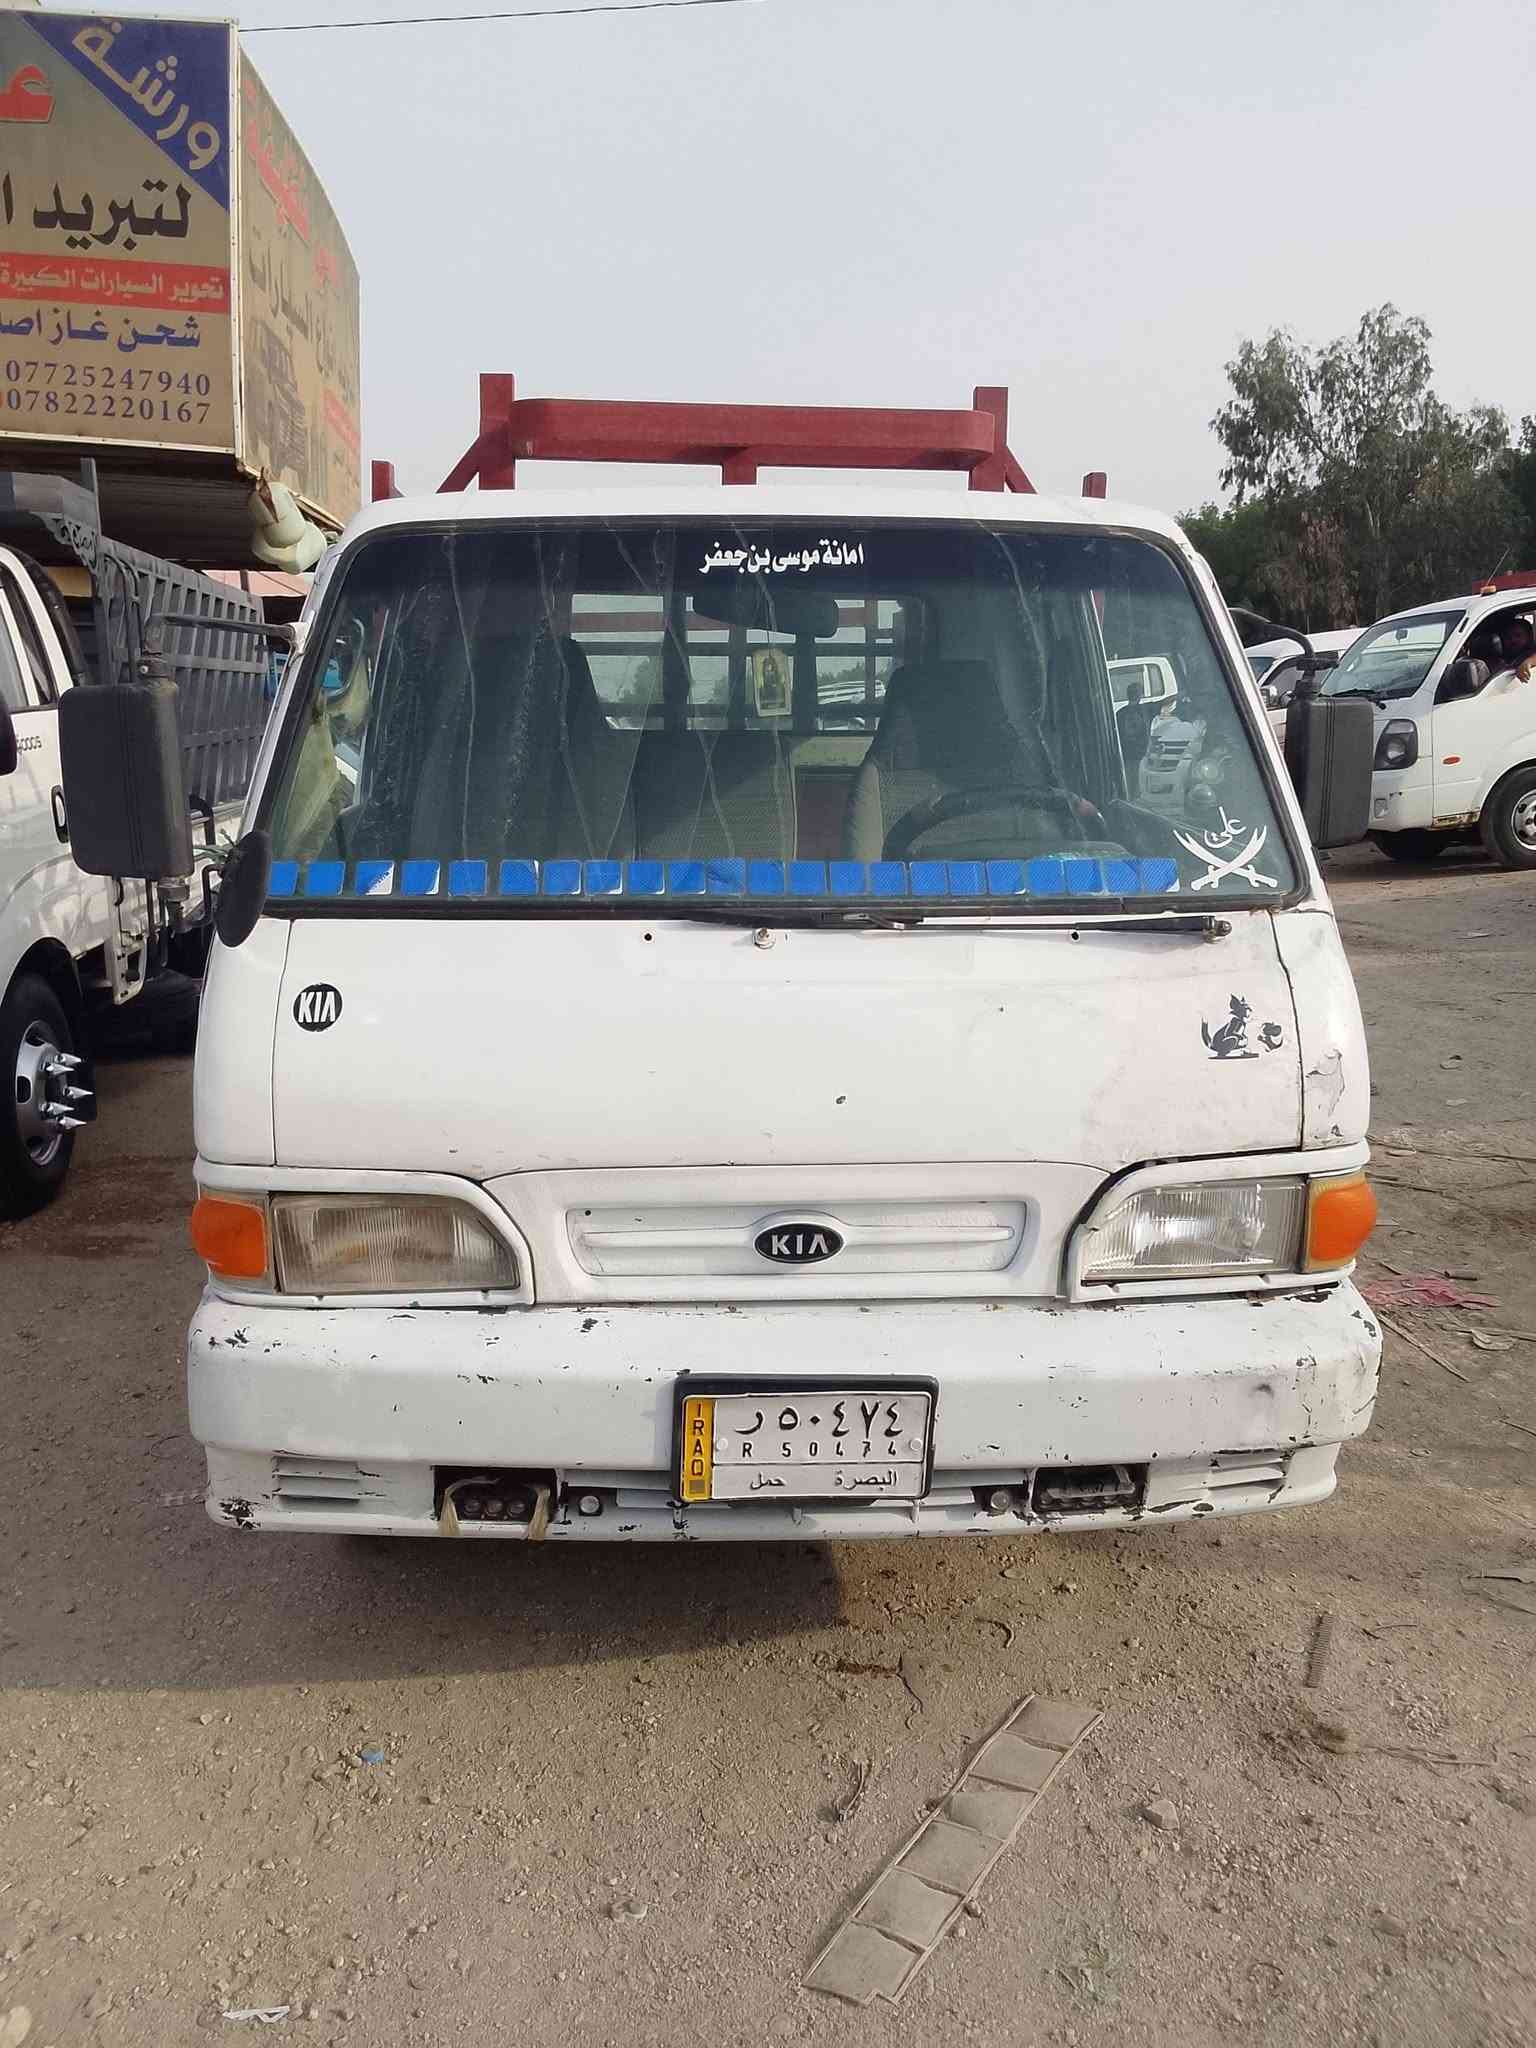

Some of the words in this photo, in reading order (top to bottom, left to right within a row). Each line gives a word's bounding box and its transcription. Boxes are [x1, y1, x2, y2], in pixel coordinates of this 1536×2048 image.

[33, 179, 192, 251] لتبريد
[80, 267, 163, 298] السيارات
[49, 309, 109, 346] غاز
[117, 315, 201, 353] شحن
[6, 360, 211, 396] 07725247940
[7, 388, 211, 424] 07822220167
[698, 541, 748, 574] جعفر
[747, 544, 772, 574] بن
[298, 991, 336, 1023] KIA
[771, 1232, 829, 1255] KIA
[692, 1403, 705, 1478] IRAQ
[749, 1471, 788, 1490] حمل
[834, 1470, 899, 1492] البصرة
